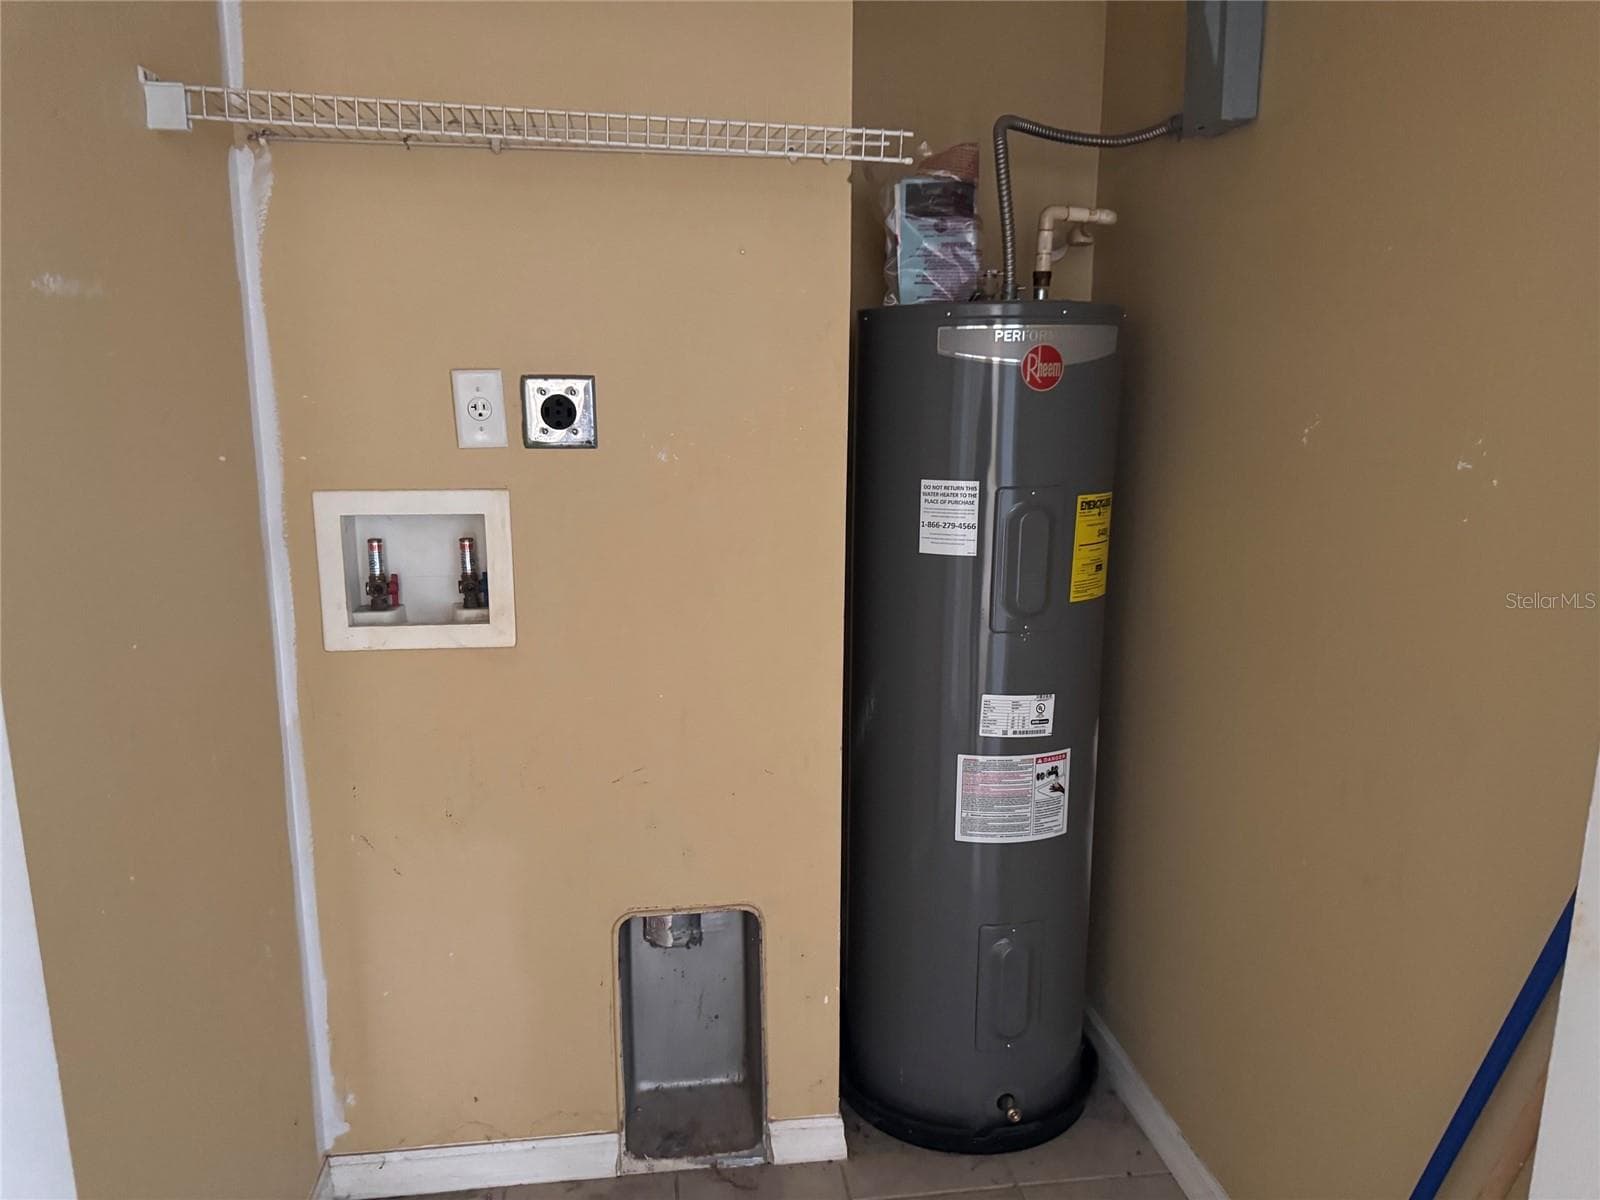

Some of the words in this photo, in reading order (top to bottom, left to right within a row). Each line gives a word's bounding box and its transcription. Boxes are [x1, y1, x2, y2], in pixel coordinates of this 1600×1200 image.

[1027, 346, 1061, 383] Rheem
[921, 521, 976, 529] 1-866-279-4566
[1043, 753, 1066, 762] DANGER
